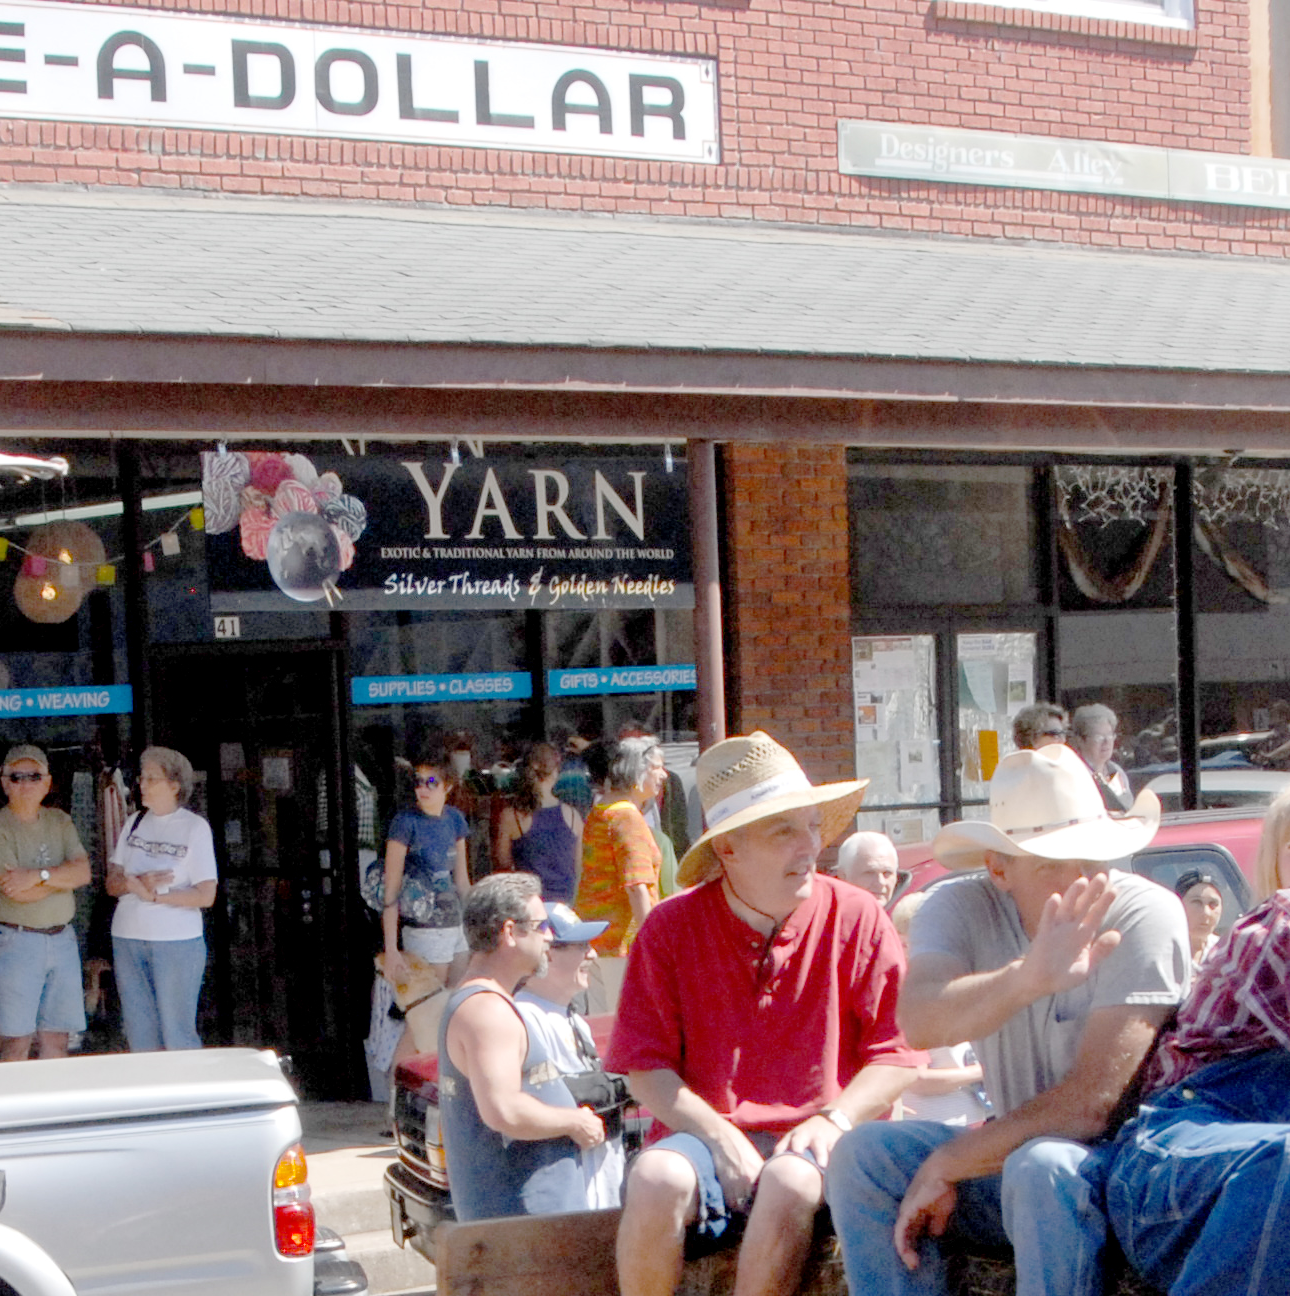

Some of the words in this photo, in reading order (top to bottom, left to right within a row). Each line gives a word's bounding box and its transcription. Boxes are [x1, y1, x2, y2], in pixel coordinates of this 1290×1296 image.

[880, 133, 1015, 173] Designers
[1047, 147, 1123, 183] Alley
[401, 461, 647, 541] YARN
[380, 547, 421, 559] EXOTIC
[422, 547, 431, 559] &
[433, 547, 506, 559] TRADITIONAL
[506, 547, 535, 559] YARN
[537, 547, 567, 559] FROM
[568, 547, 614, 560] AROUND
[615, 547, 637, 560] THE
[637, 548, 675, 560] WORLD
[383, 572, 446, 596] Silver
[448, 570, 521, 602] Threads
[548, 572, 608, 605] Golden
[610, 572, 676, 602] Needles
[217, 619, 237, 636] 41
[367, 680, 436, 698] SUPPLIES
[448, 677, 513, 695] CLASSES
[559, 673, 598, 690] GIFTS
[610, 669, 697, 687] ACCESSORIES
[37, 691, 111, 711] WEAVING
